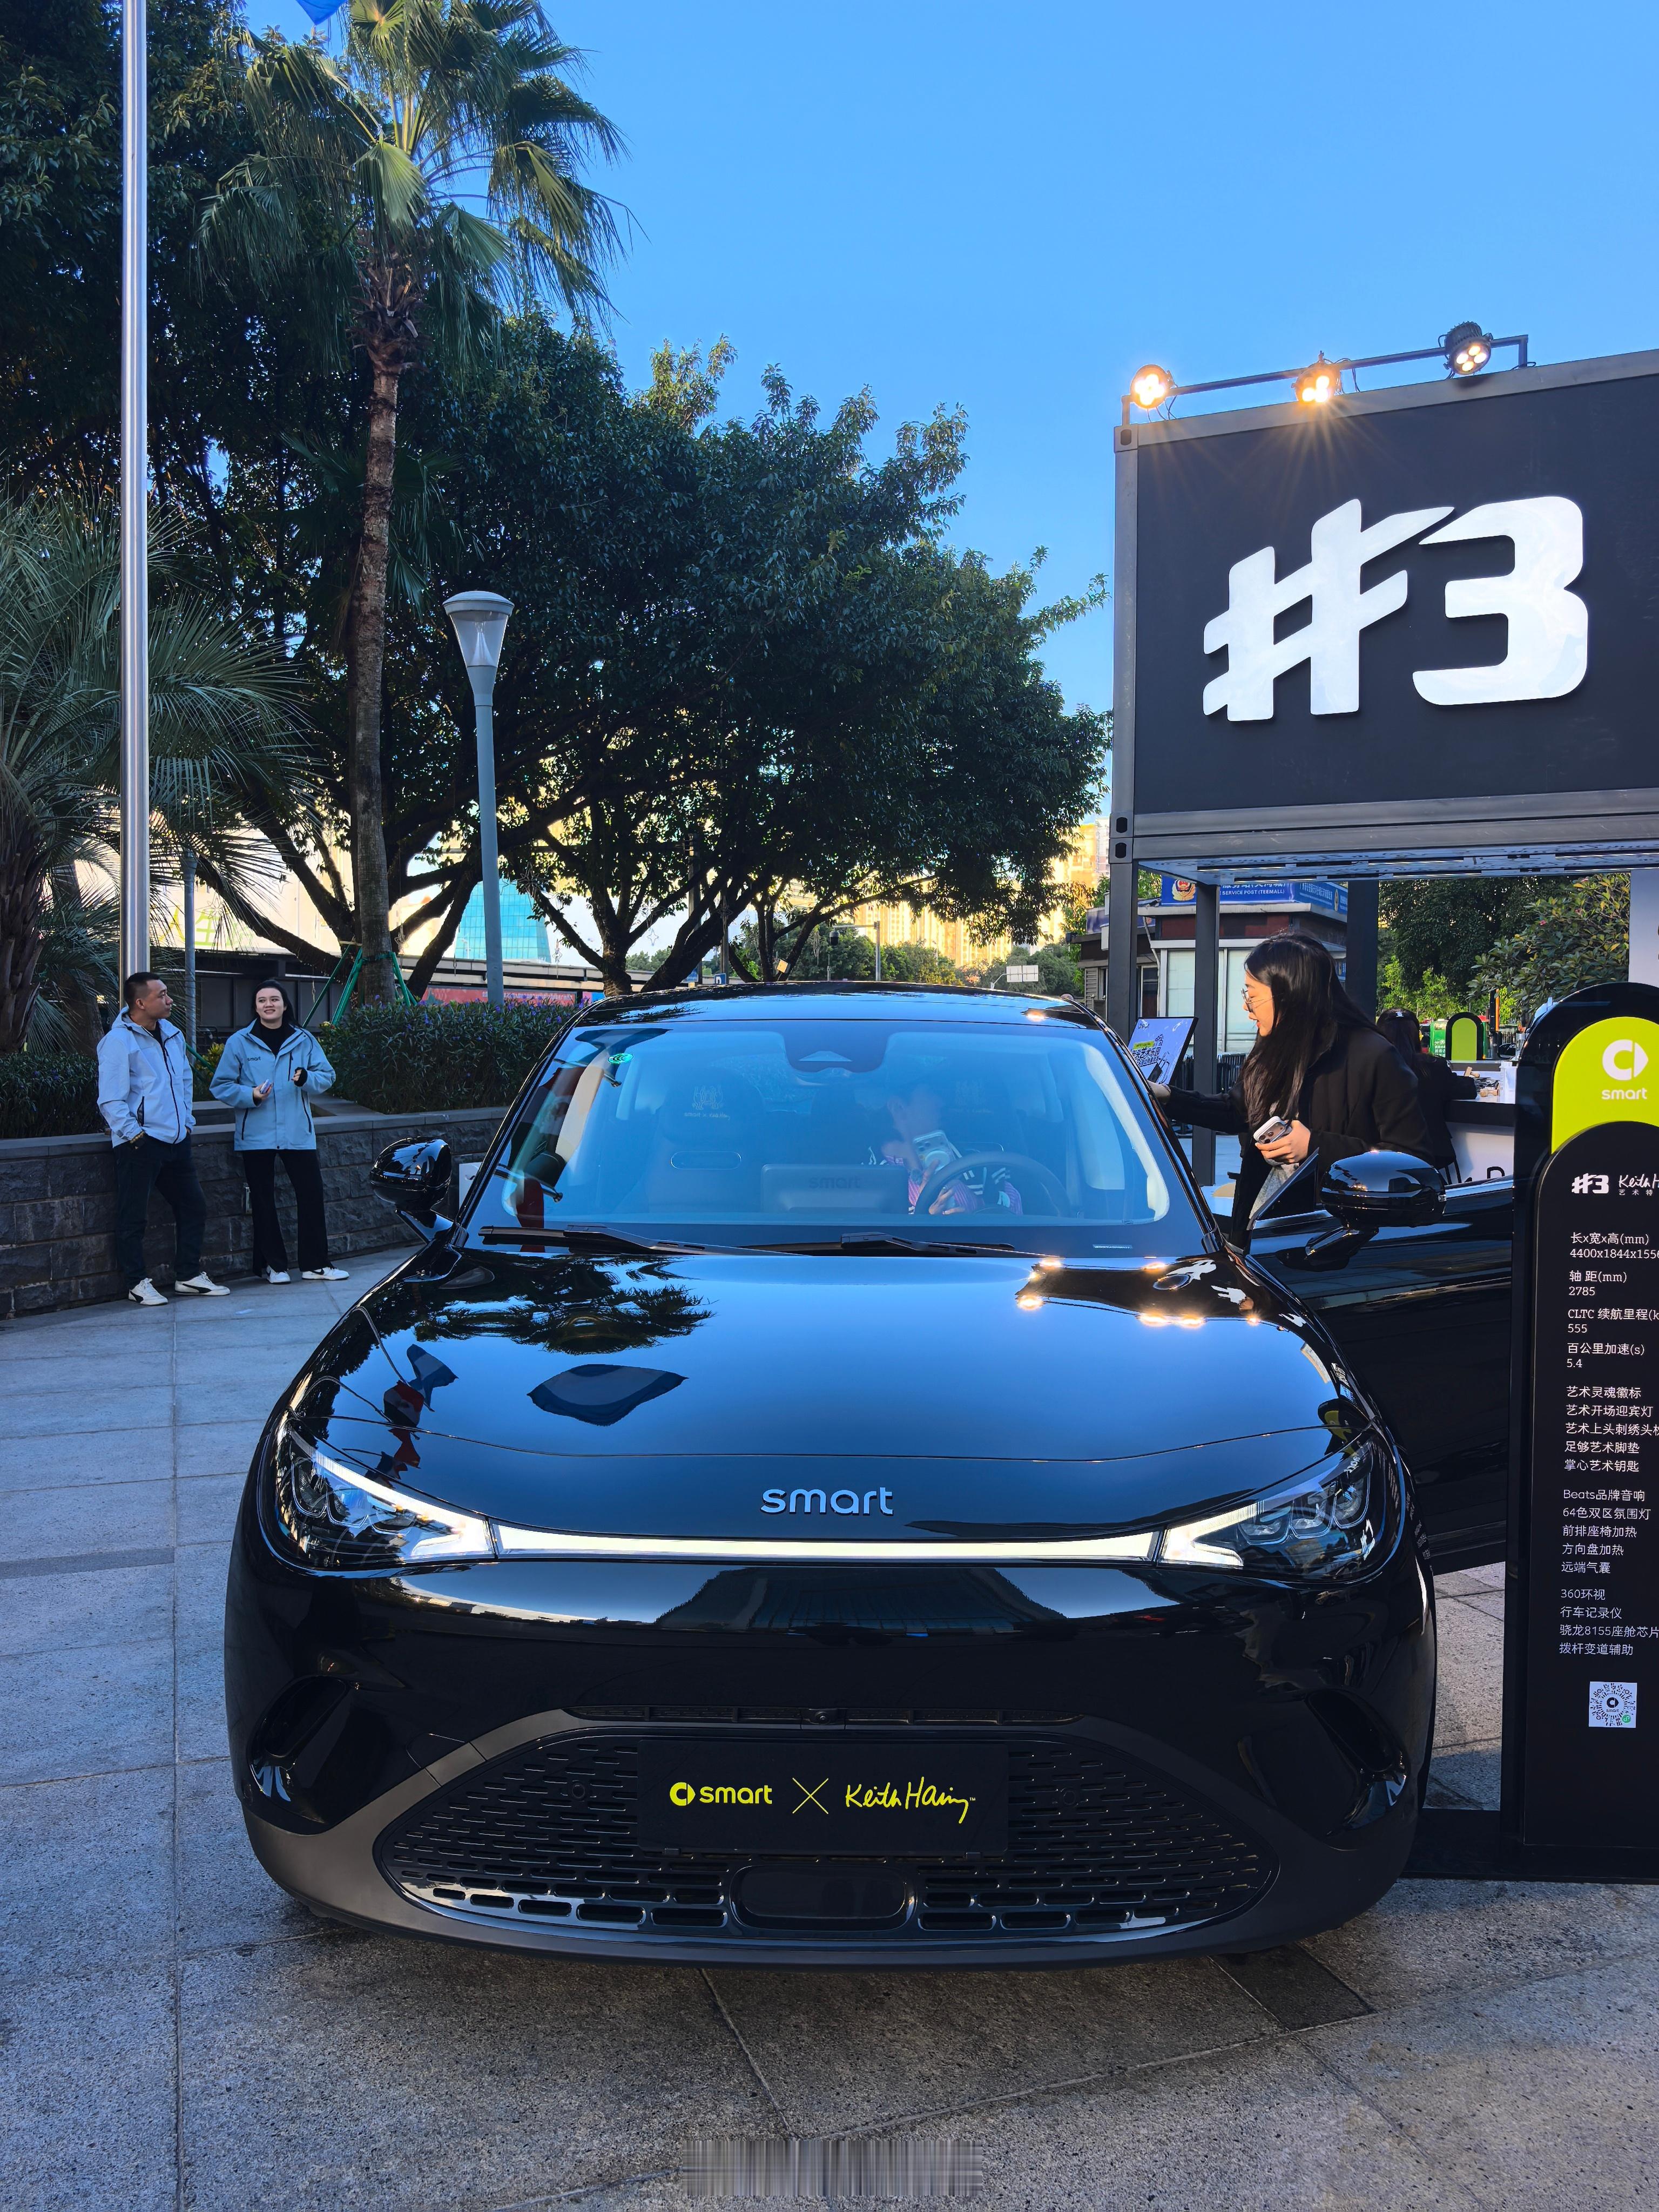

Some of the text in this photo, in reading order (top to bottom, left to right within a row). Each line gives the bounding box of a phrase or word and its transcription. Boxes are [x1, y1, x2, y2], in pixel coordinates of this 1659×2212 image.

[1203, 496, 1588, 721] #3
[1601, 1088, 1647, 1100] smart
[1571, 1173, 1609, 1193] #3
[1568, 1286, 1595, 1296] 2785
[1568, 1309, 1594, 1319] CLTC
[1568, 1324, 1587, 1333] 555
[1567, 1343, 1645, 1355] 百公里加速(s)
[1567, 1358, 1582, 1367] 5.4
[1566, 1385, 1641, 1399] 艺术灵魂徽标
[1566, 1404, 1653, 1418] 艺术开场迎宾灯
[1564, 1441, 1640, 1454] 足够艺术脚垫
[1564, 1459, 1640, 1472] 掌心艺术钥匙
[760, 1487, 893, 1515] smart
[1563, 1489, 1645, 1502] Beats品牌音响
[1563, 1507, 1651, 1520] 64色双区氛围灯
[1562, 1525, 1637, 1538] 前排座椅加热
[1562, 1543, 1624, 1555] 方向盘加热
[1561, 1561, 1611, 1574] 远端气囊
[1561, 1589, 1606, 1600] 360环视
[1560, 1606, 1622, 1619] 行车记录仪
[1559, 1624, 1659, 1638] 骁龙8155座舱芯片
[1559, 1642, 1634, 1656] 拨杆变道辅助
[700, 1784, 772, 1804] smart
[845, 1782, 902, 1808] Keith
